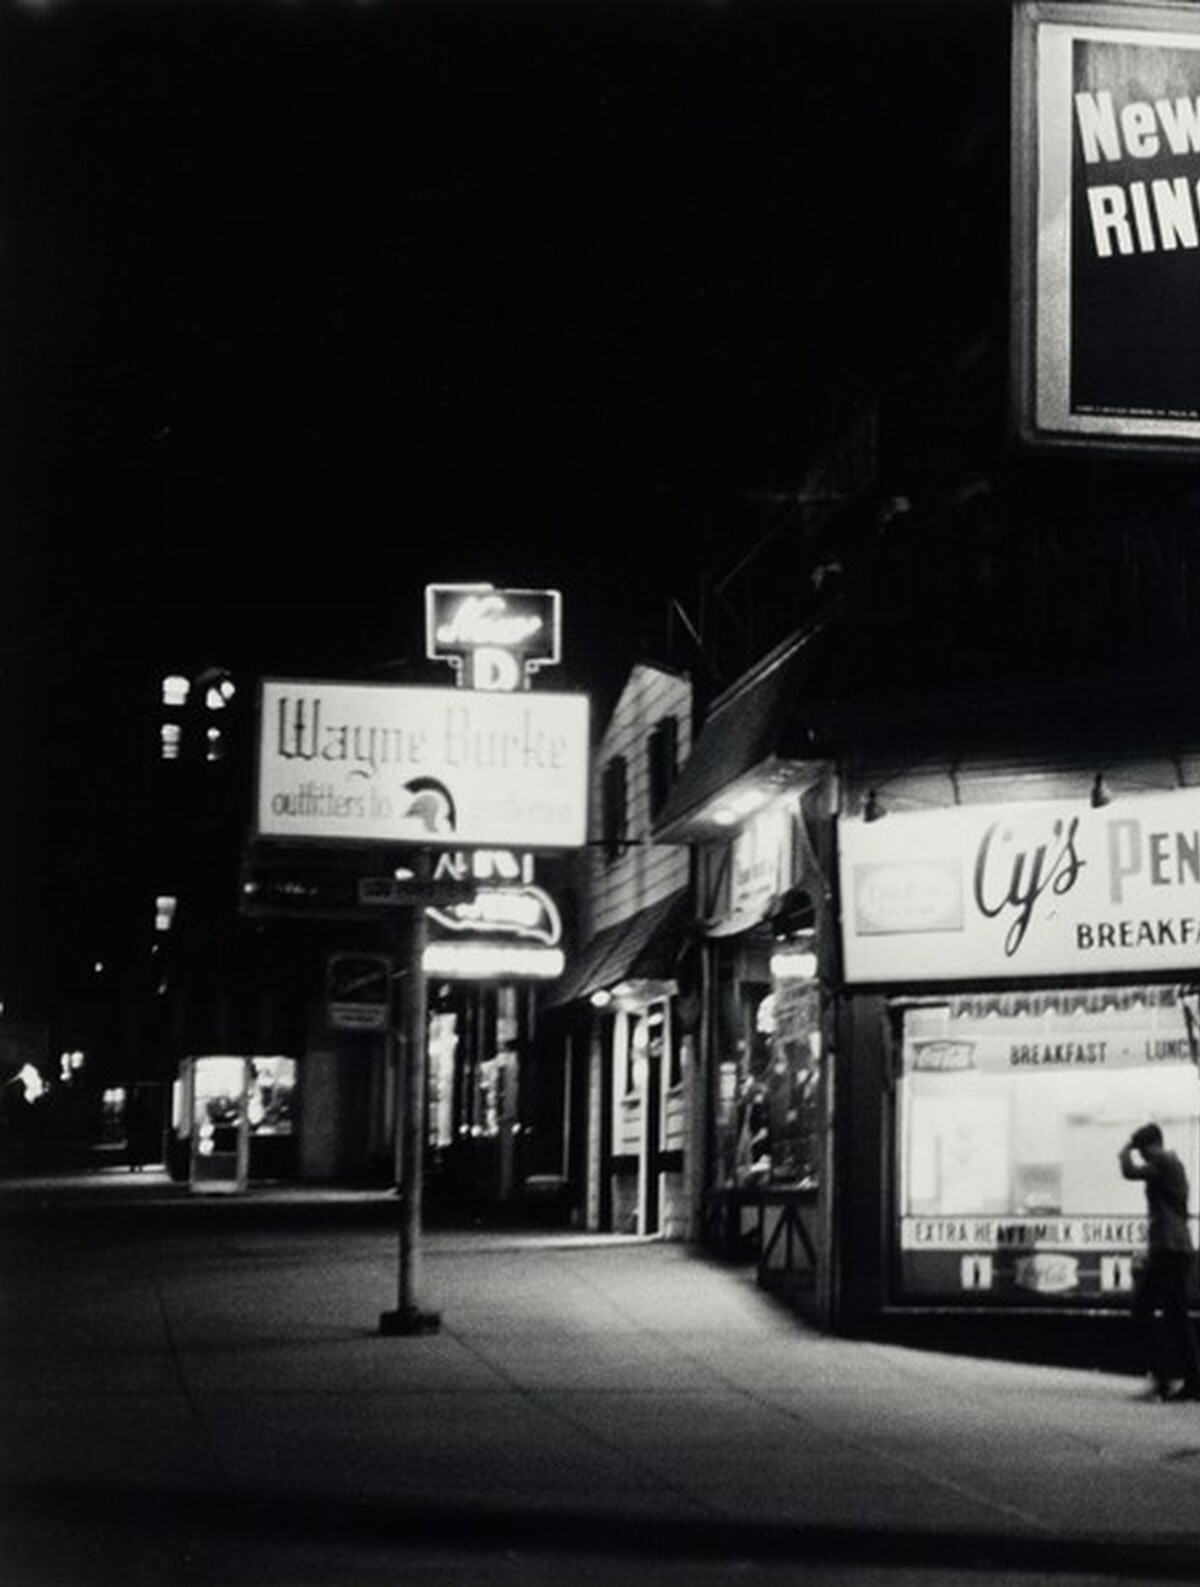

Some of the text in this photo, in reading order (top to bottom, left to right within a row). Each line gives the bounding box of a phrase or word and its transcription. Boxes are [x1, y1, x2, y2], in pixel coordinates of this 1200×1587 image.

[277, 696, 568, 780] Wayne Burke
[973, 816, 1086, 957] Cy's
[1010, 1041, 1107, 1066] BREAKFAST
[914, 1221, 967, 1243] EXTRA
[974, 1221, 1028, 1243] HEAVY
[1082, 1221, 1148, 1243] SHAKES
